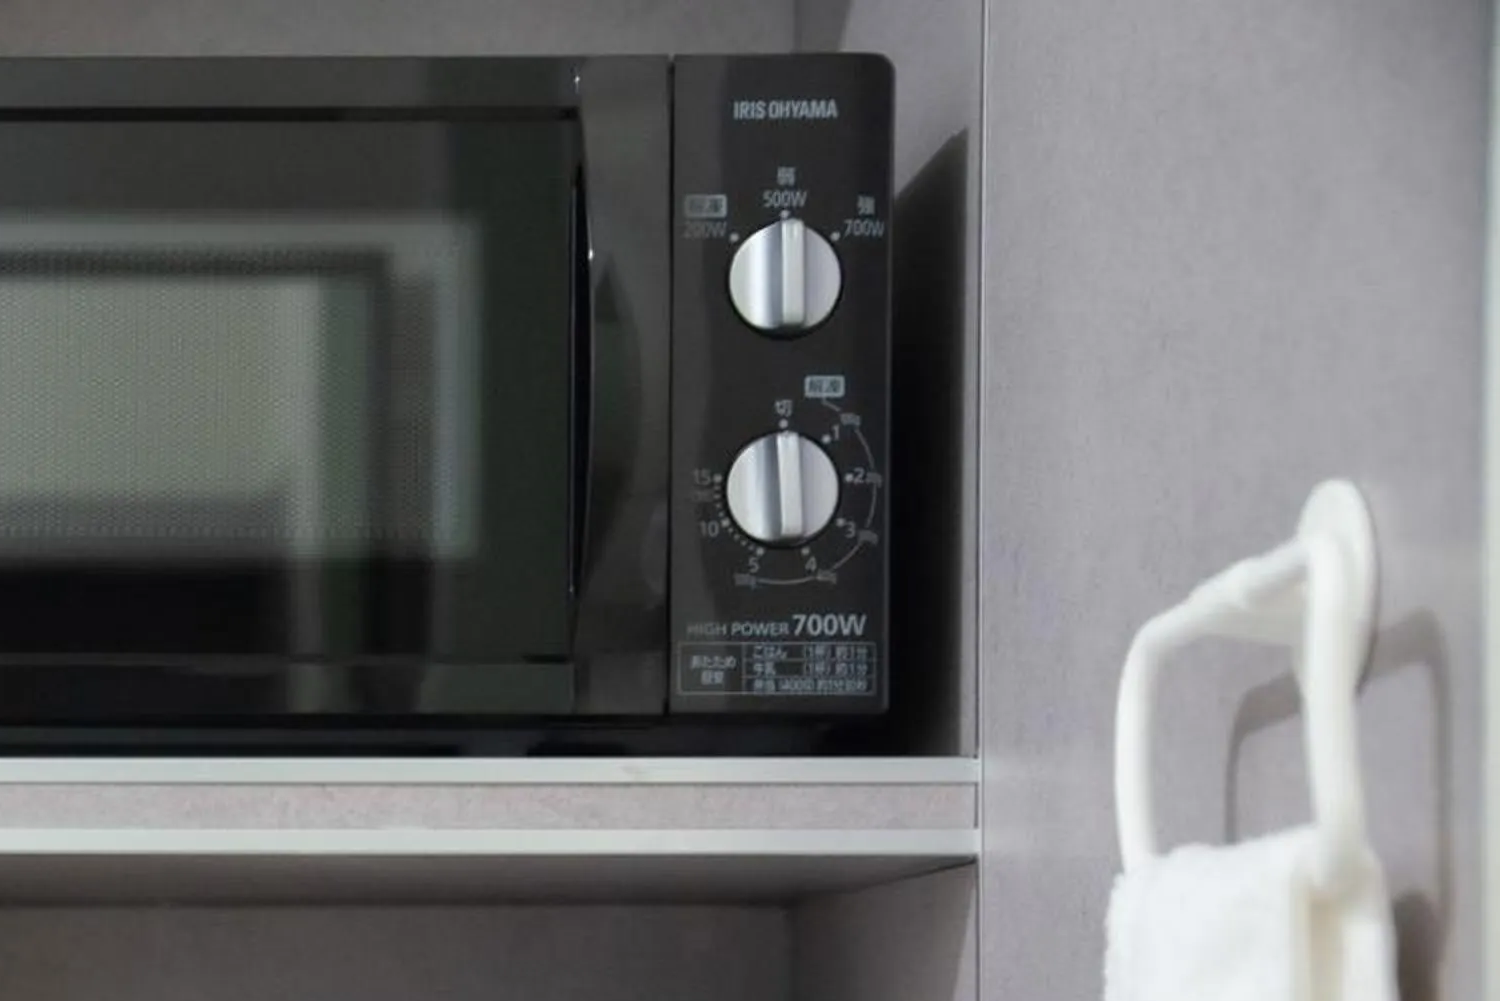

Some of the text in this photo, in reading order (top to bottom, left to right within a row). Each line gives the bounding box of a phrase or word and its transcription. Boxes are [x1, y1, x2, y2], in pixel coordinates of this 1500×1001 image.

[733, 99, 838, 120] IRIS OHYAMA
[763, 190, 807, 208] 500W
[844, 219, 885, 237] 700W
[832, 425, 840, 440] 1
[694, 469, 711, 486] 15
[853, 468, 865, 485] 2
[701, 520, 719, 537] 10
[846, 521, 856, 538] 3
[749, 557, 759, 573] 5
[805, 556, 817, 572] 4
[686, 613, 867, 636] HIGH POWER 700W
